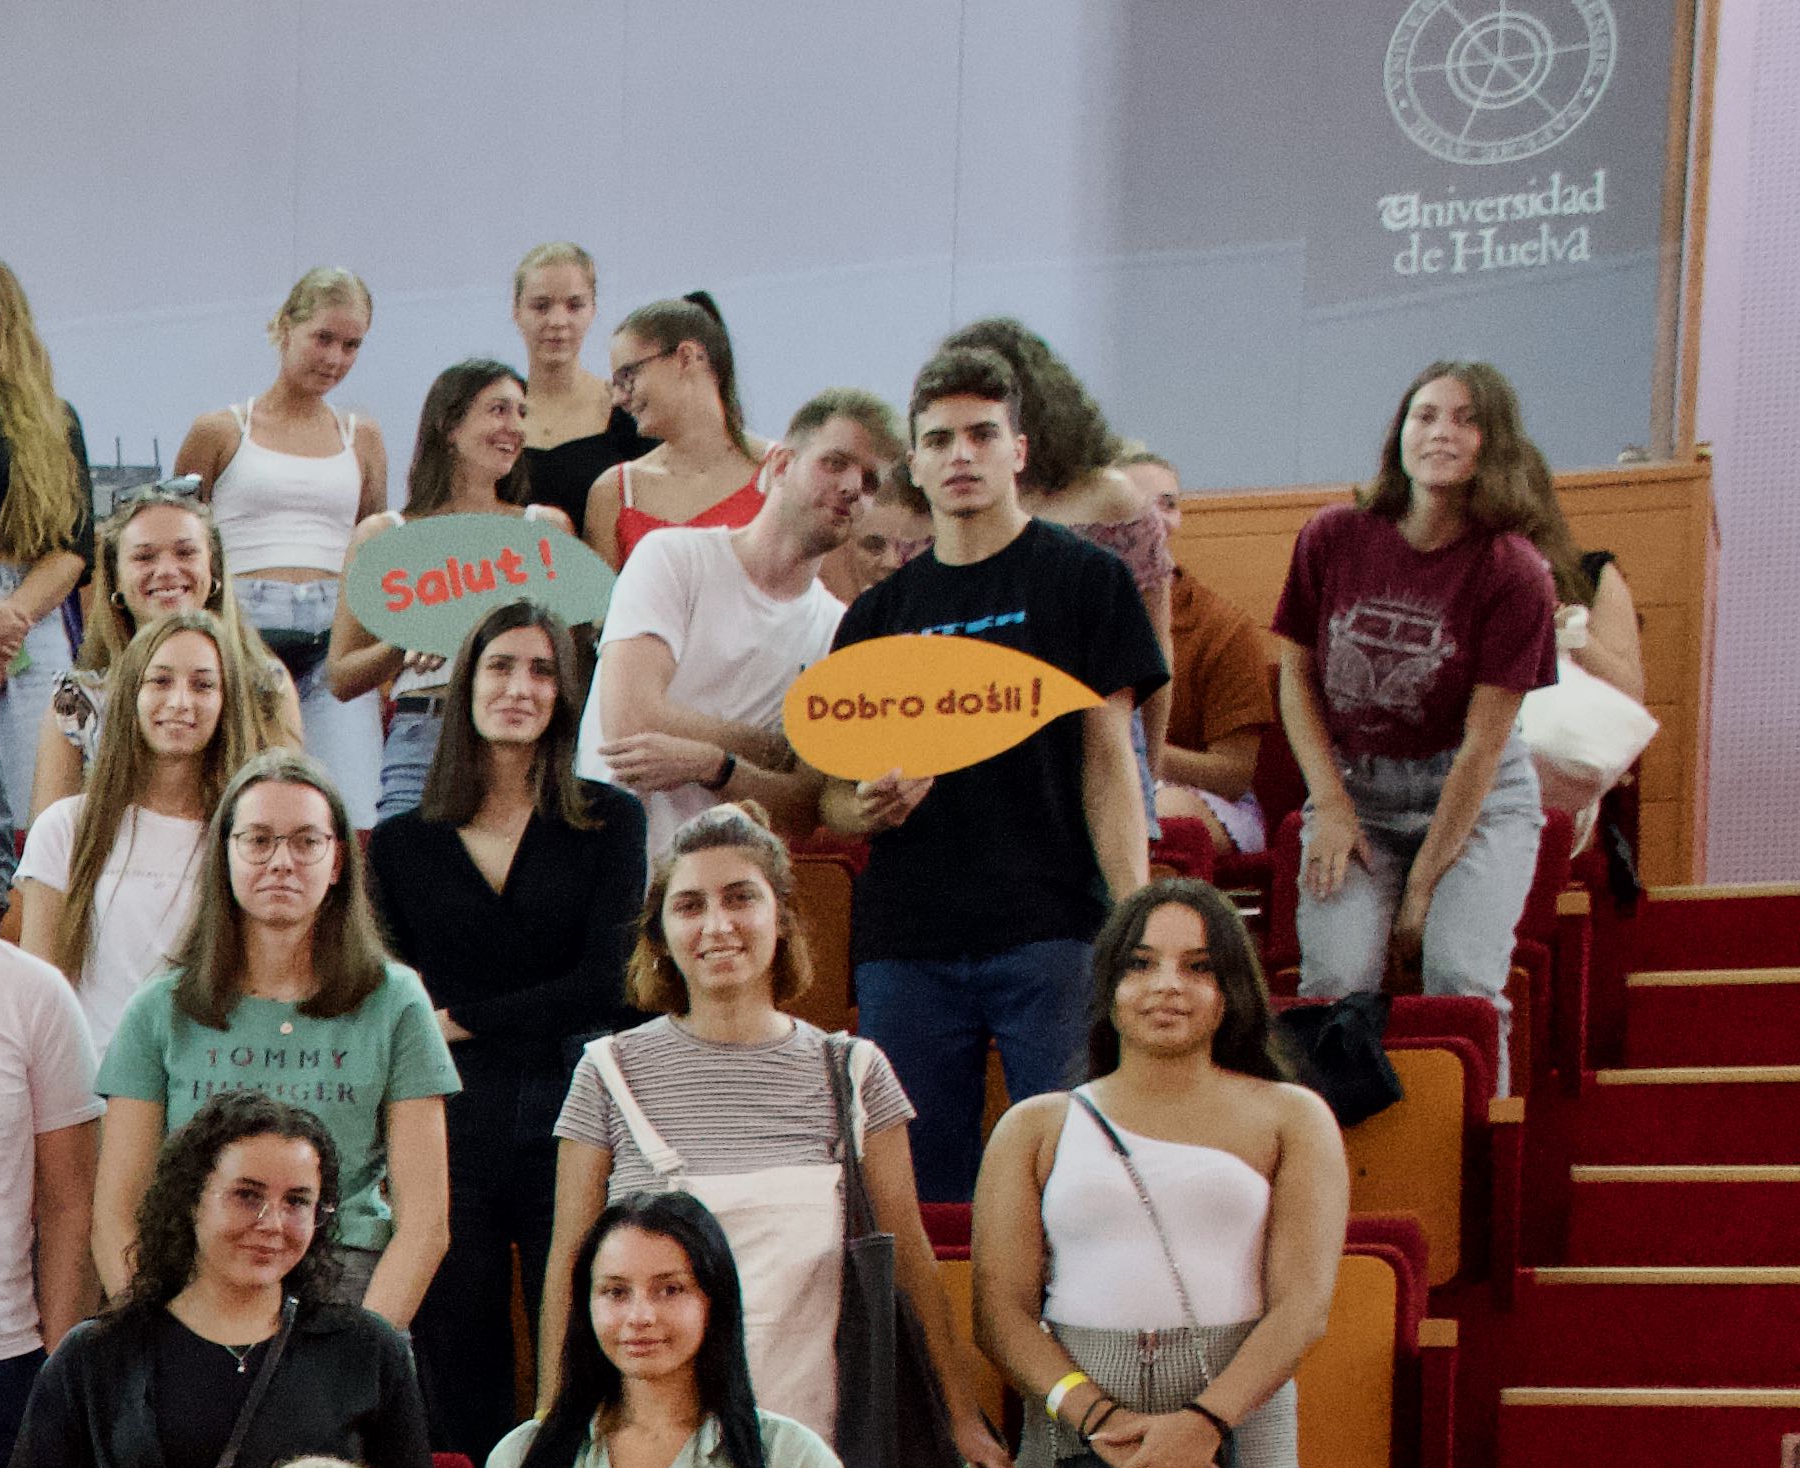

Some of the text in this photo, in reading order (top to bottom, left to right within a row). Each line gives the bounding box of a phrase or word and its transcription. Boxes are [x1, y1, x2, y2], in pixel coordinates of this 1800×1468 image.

[1377, 168, 1606, 231] Universidad
[1393, 222, 1591, 275] de Huelva
[380, 546, 529, 613] Salut
[806, 692, 925, 721] Dobro
[207, 1047, 348, 1070] TOMMY
